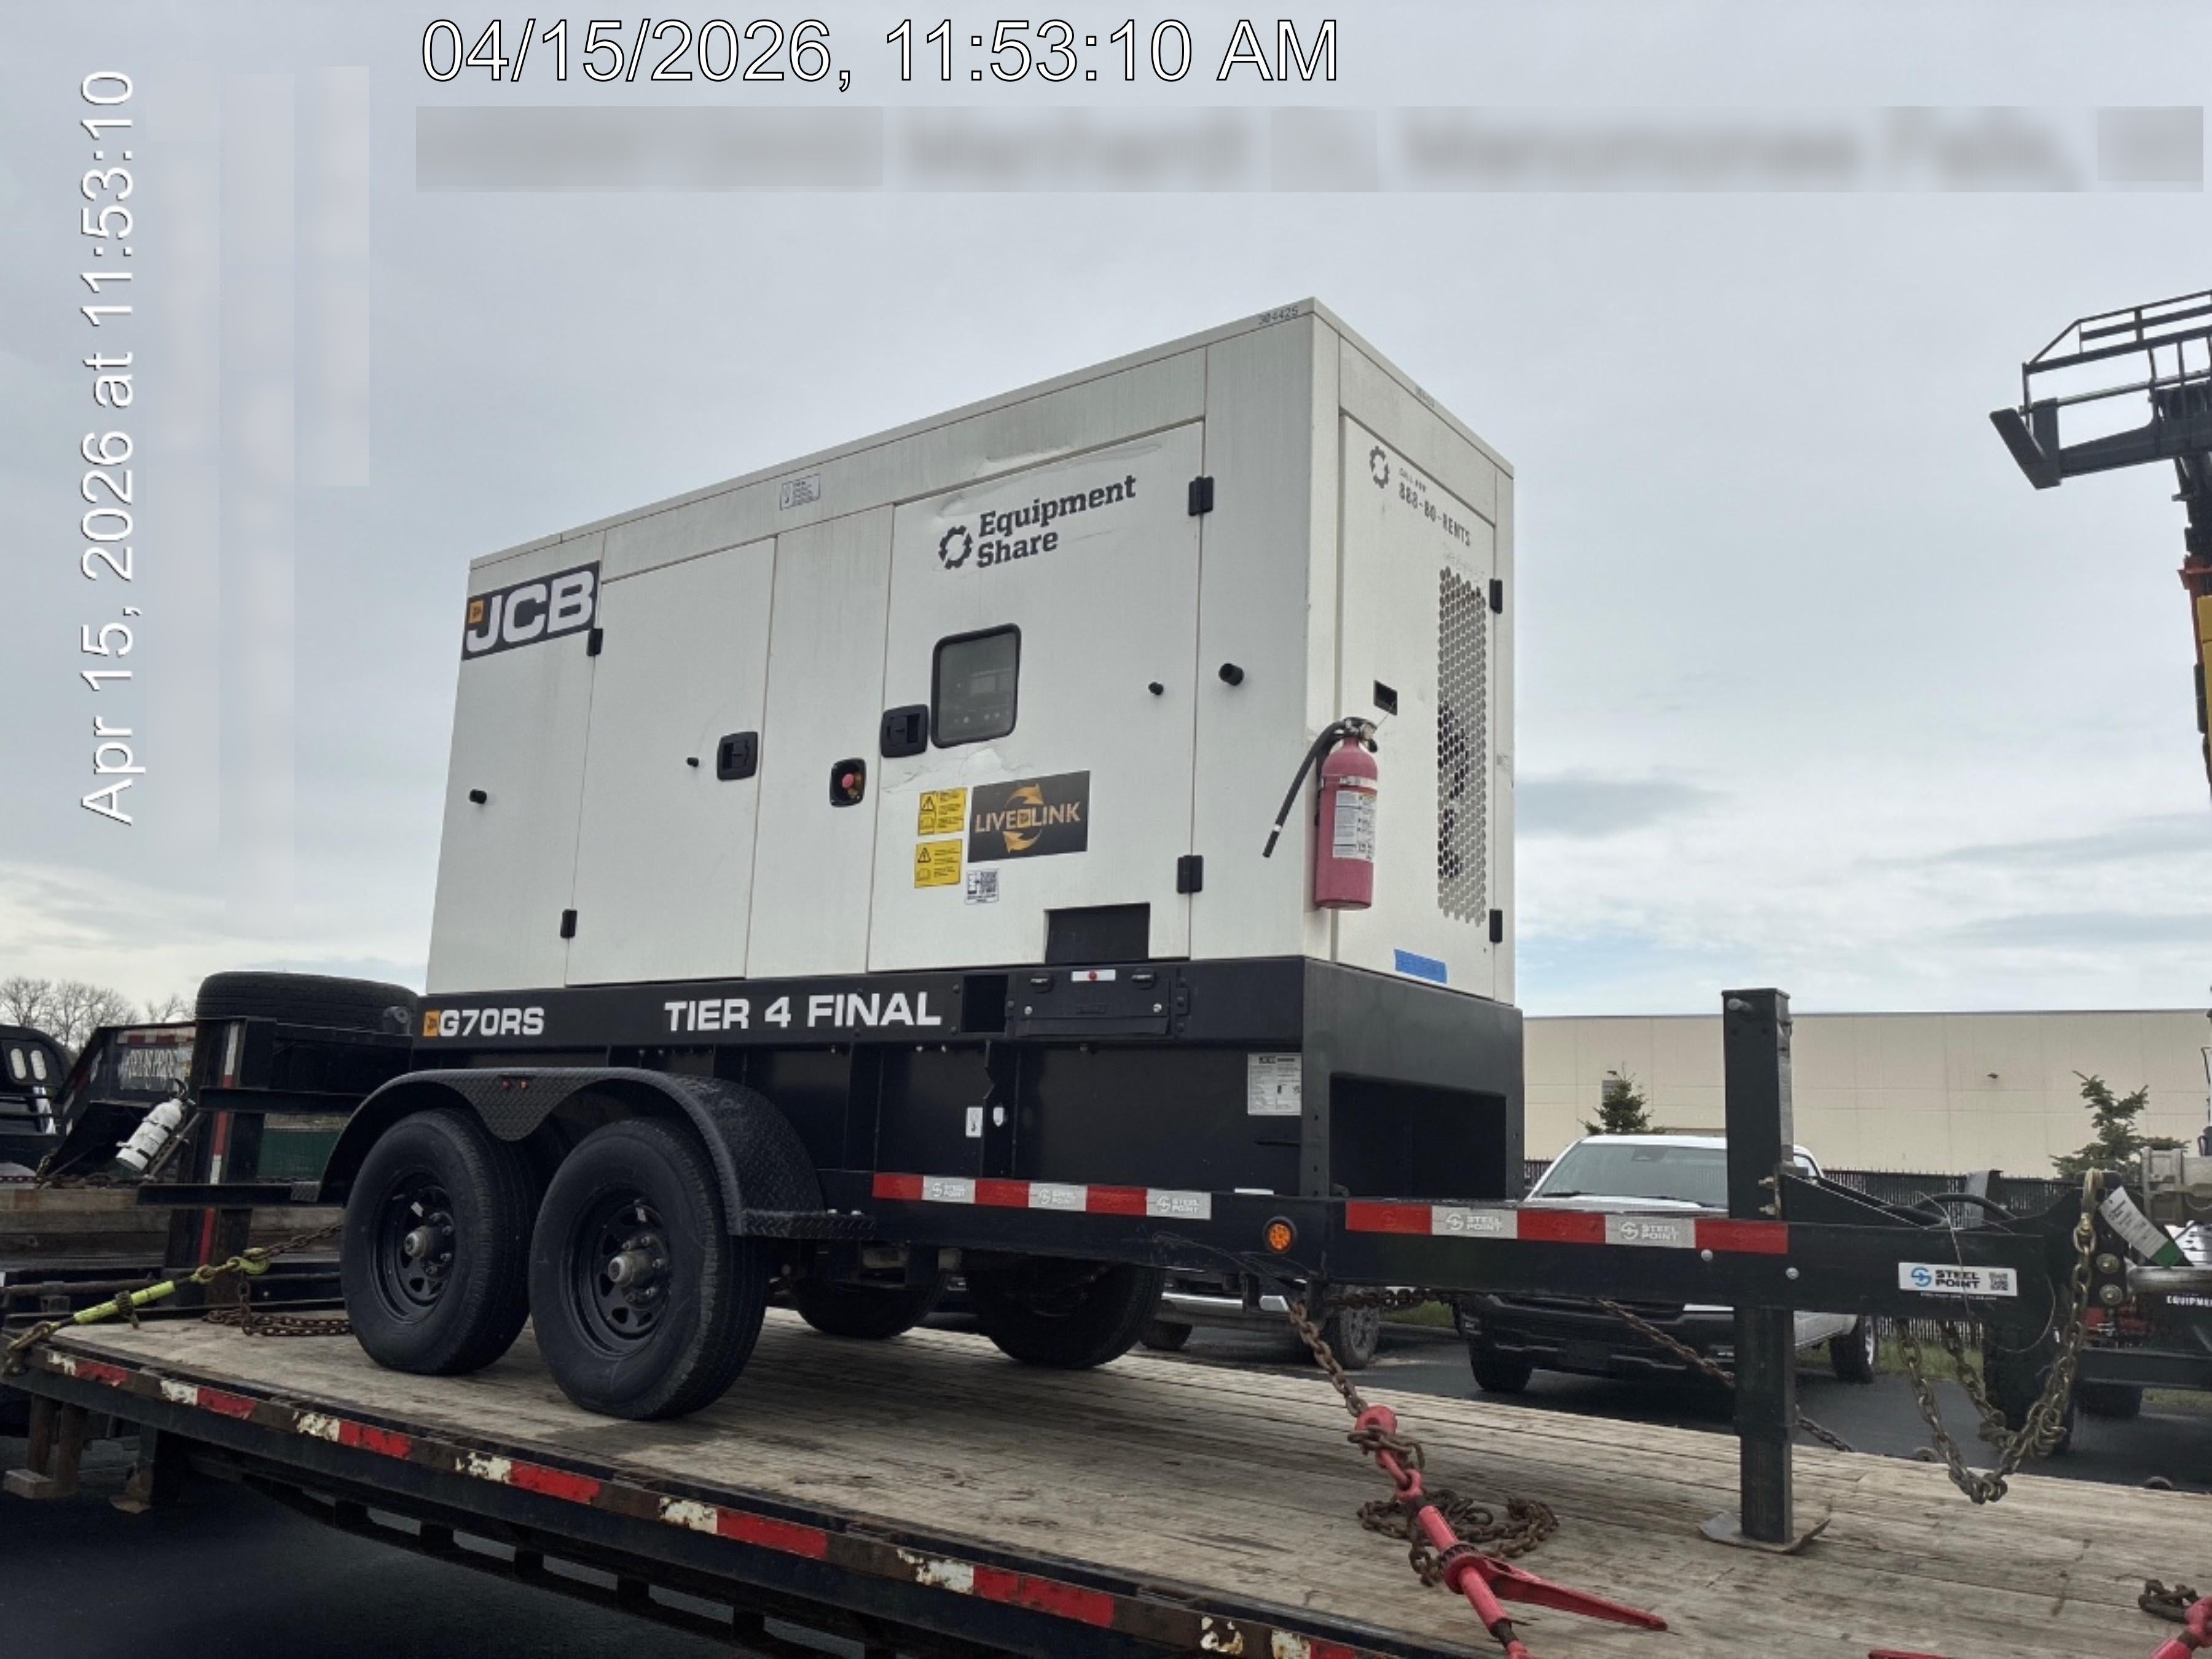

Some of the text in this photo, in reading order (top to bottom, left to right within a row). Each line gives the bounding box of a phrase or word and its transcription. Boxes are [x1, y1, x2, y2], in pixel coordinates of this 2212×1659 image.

[979, 475, 1136, 538] Equipment
[977, 531, 1059, 568] Share
[466, 570, 595, 653] JCB
[439, 1006, 545, 1037] G70RS
[664, 991, 942, 1032] TIER 4 FINAL
[1641, 1224, 1676, 1233] STEEL
[1641, 1232, 1678, 1241] POINT
[1936, 1269, 1980, 1279] STEEL
[1936, 1279, 1980, 1288] POINT
